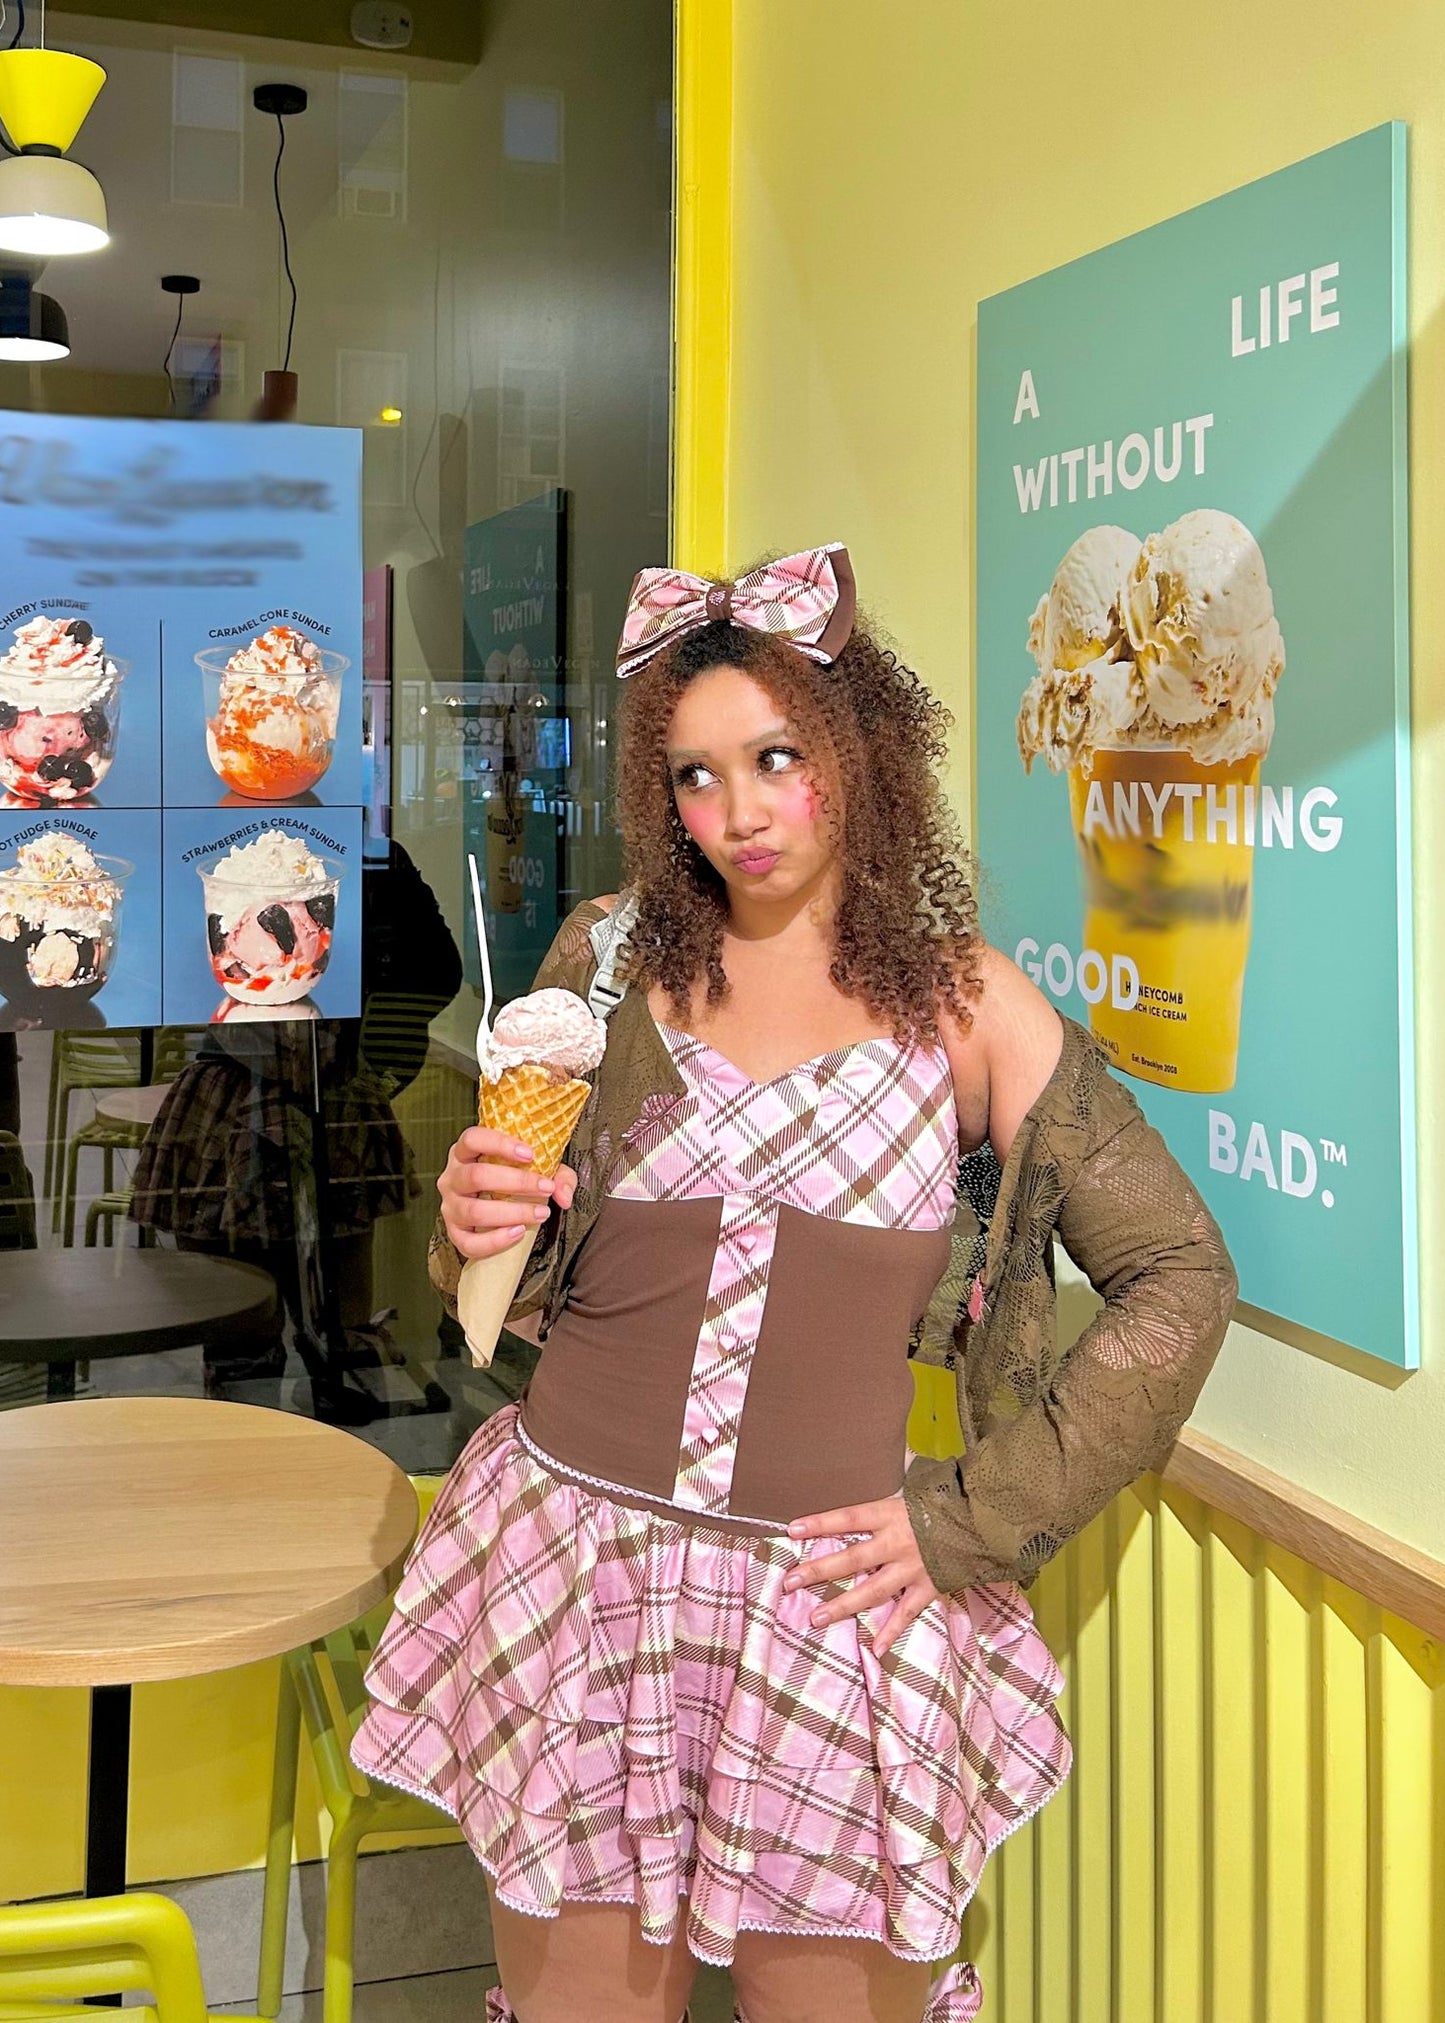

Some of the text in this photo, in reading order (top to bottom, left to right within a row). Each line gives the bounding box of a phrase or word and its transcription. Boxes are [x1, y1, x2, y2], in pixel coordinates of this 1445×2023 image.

[1012, 262, 1340, 425] A LIFE
[1012, 413, 1214, 513] WITHOUT
[0, 602, 37, 630] CHERRY
[208, 609, 331, 638] CARAMEL CONE SUNDAE
[1083, 781, 1344, 853] ANYTHING
[0, 819, 98, 850] OT FUDGE SUNDAE
[182, 818, 347, 863] STRAWBERRIES & CREAM SUNDAE
[1014, 937, 1140, 1012] GOOD
[1125, 981, 1183, 1004] HNEYCOMB
[1149, 1006, 1160, 1017] ICE
[1162, 1009, 1188, 1021] CREAM
[1141, 1057, 1163, 1072] Brooklyn
